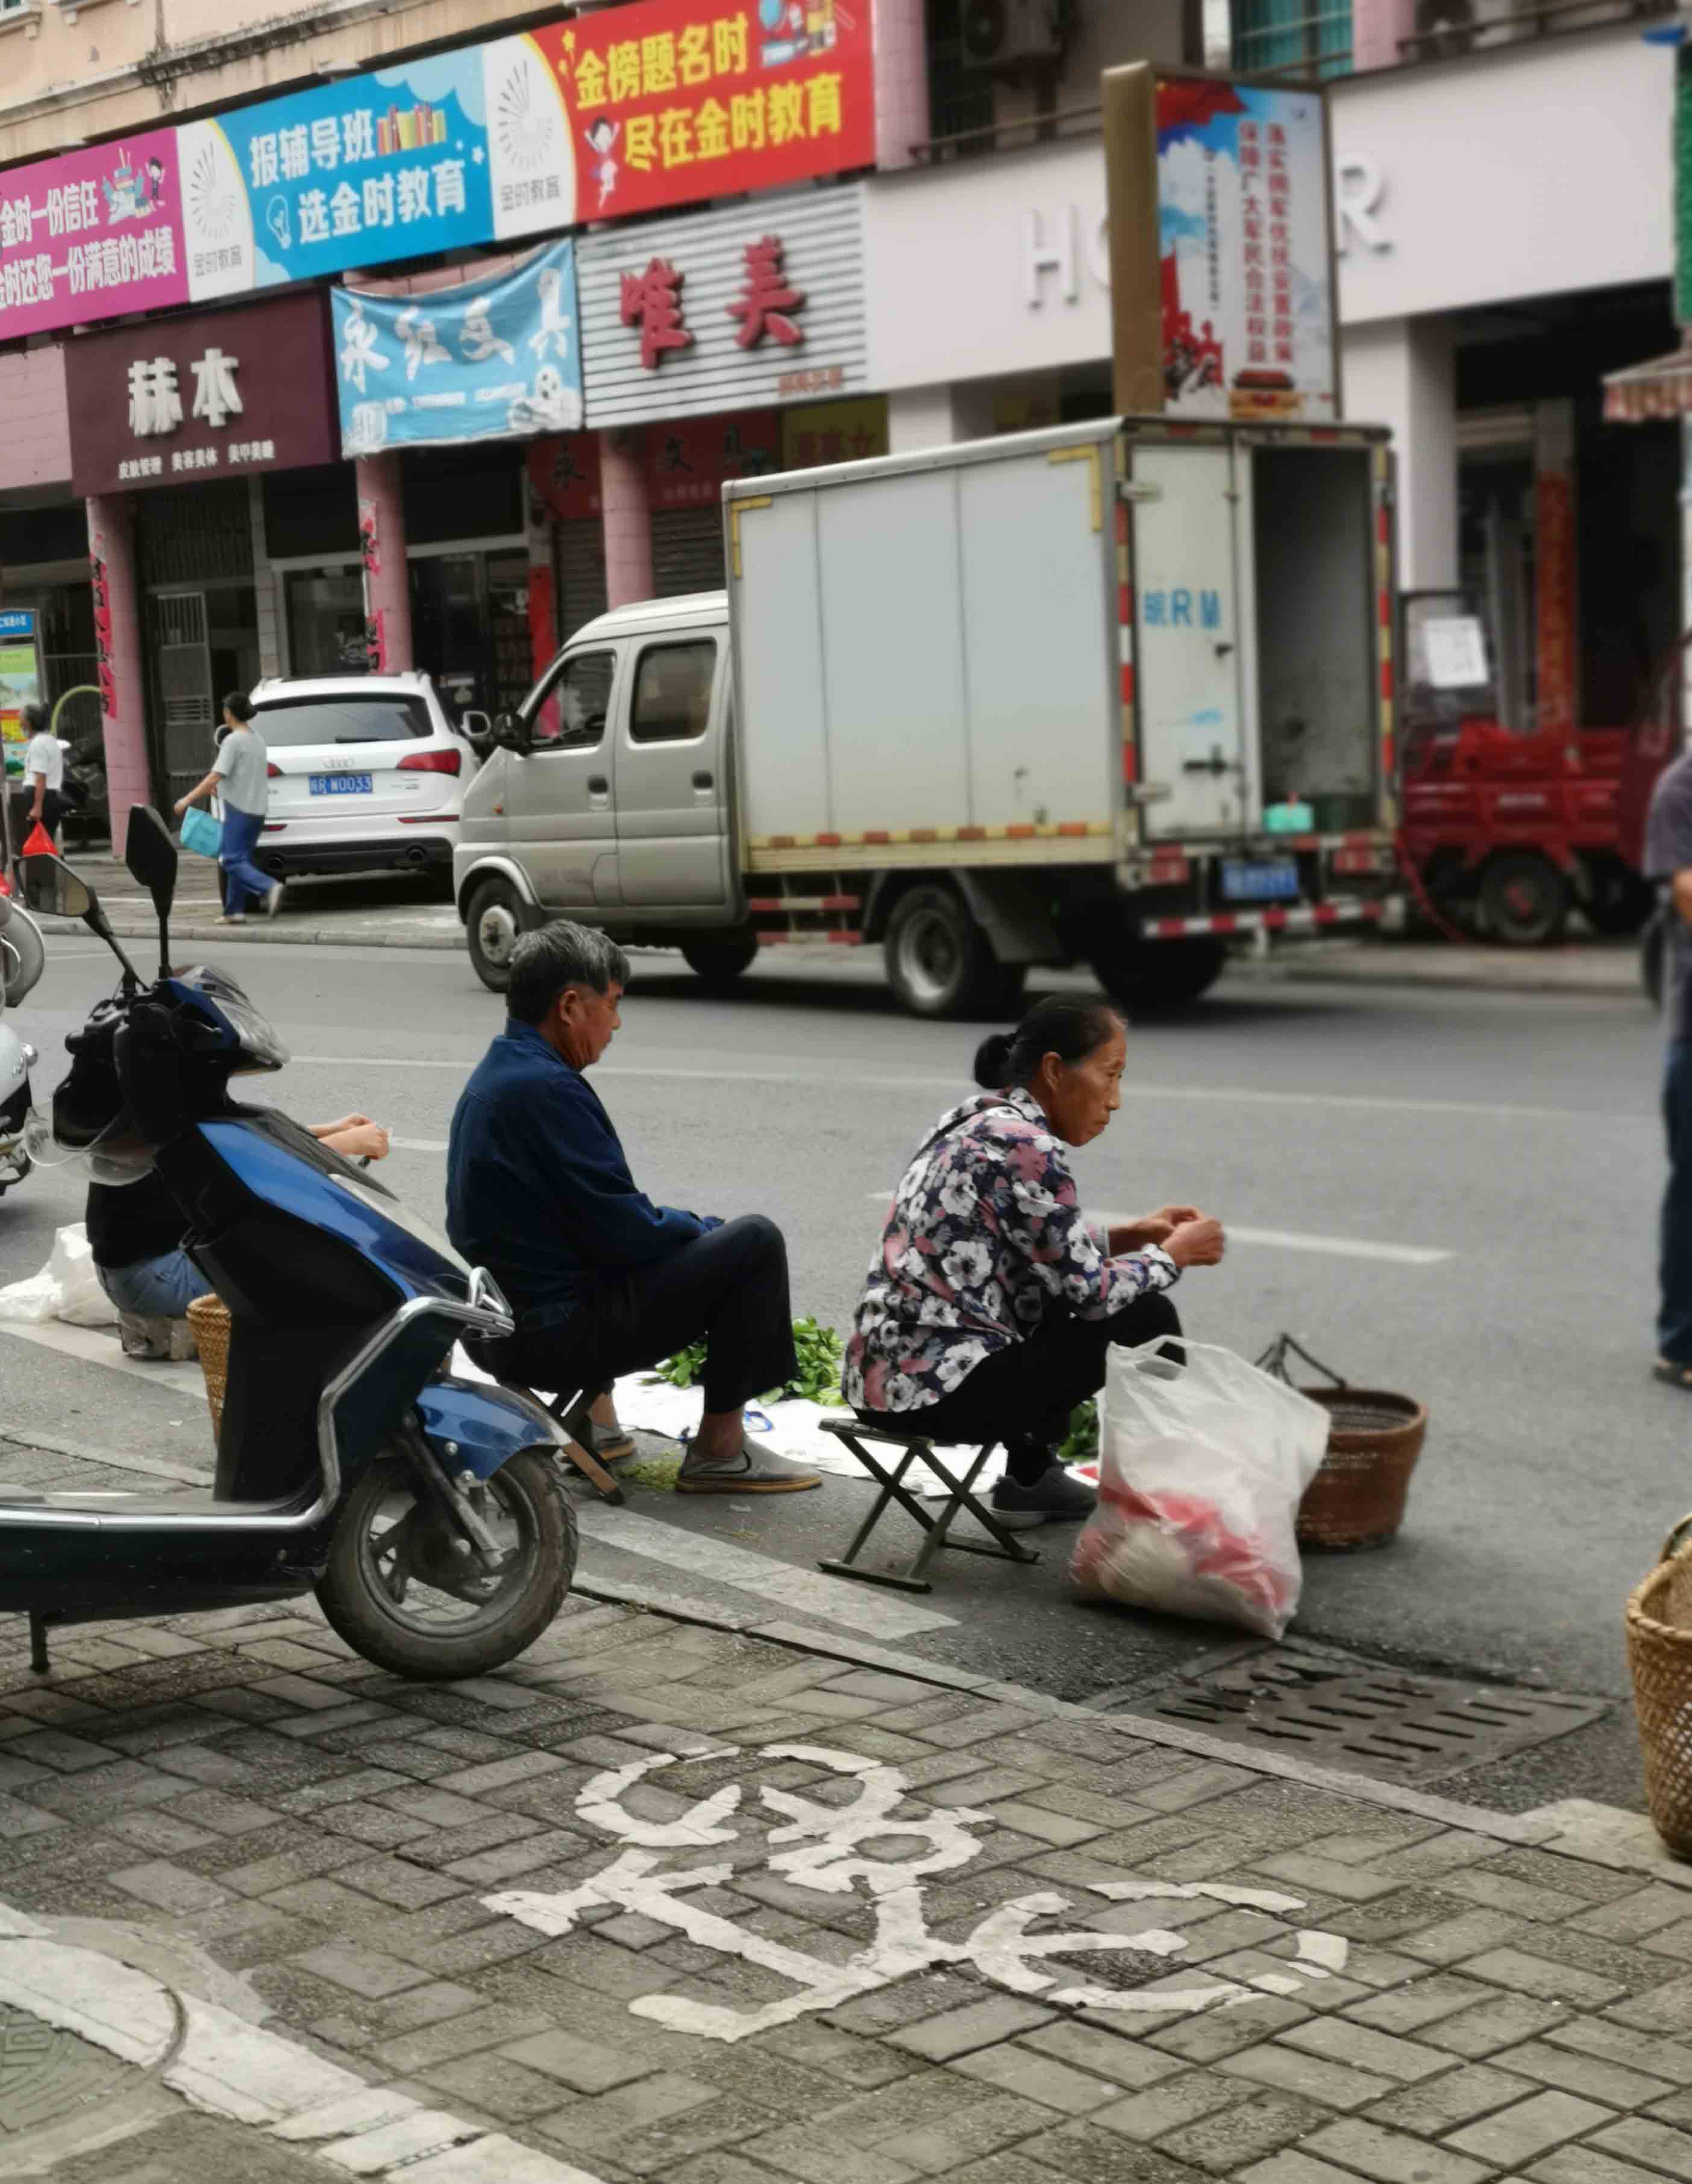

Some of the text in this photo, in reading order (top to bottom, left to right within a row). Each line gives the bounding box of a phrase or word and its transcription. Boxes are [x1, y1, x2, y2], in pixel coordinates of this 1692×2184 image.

[574, 11, 748, 110] 金榜题名时
[249, 108, 376, 189] 报辅导班
[624, 72, 842, 172] 尽在金时教育
[298, 158, 467, 244] 选金时教育
[501, 174, 561, 212] 金时教育
[193, 243, 243, 278] 金时教育
[619, 234, 808, 372] 唯美
